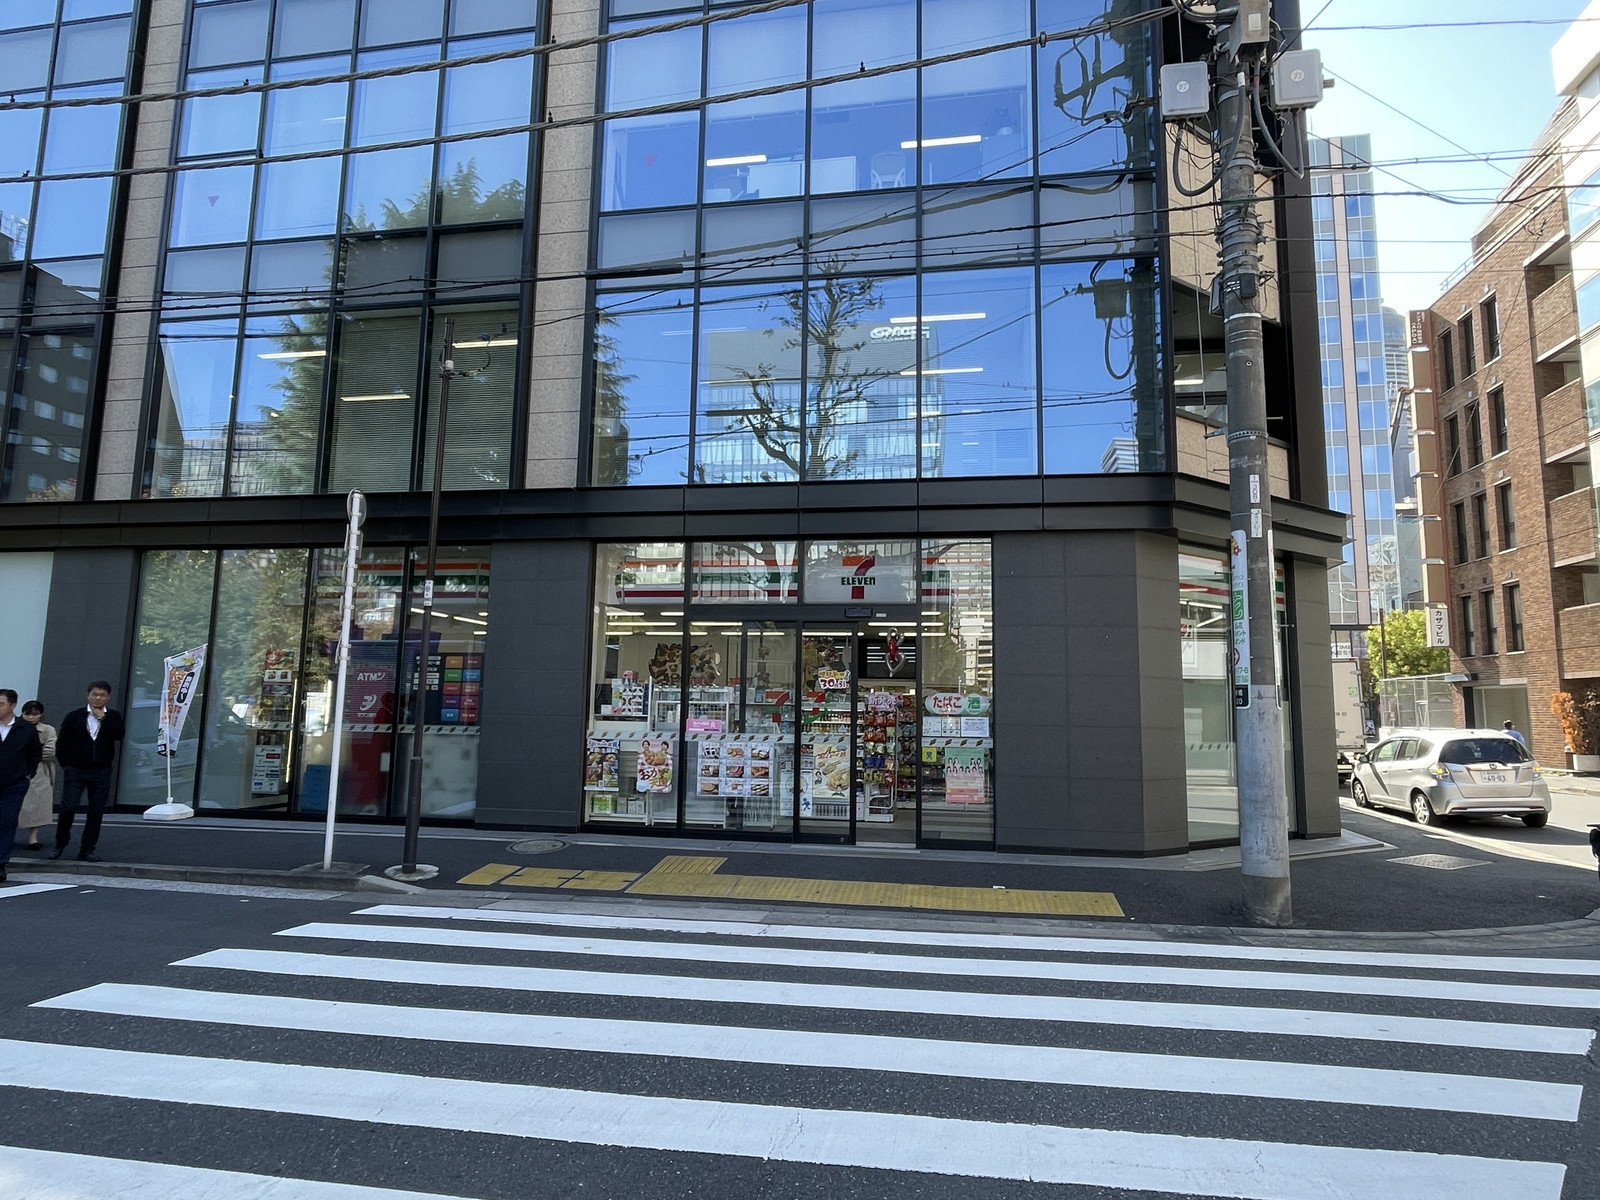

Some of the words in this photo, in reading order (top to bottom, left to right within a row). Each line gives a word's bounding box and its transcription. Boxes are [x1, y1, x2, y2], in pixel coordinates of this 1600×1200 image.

[1435, 610, 1445, 645] カサマビル
[357, 672, 378, 681] ATM
[932, 695, 962, 709] たばこ
[967, 696, 981, 709] 酒
